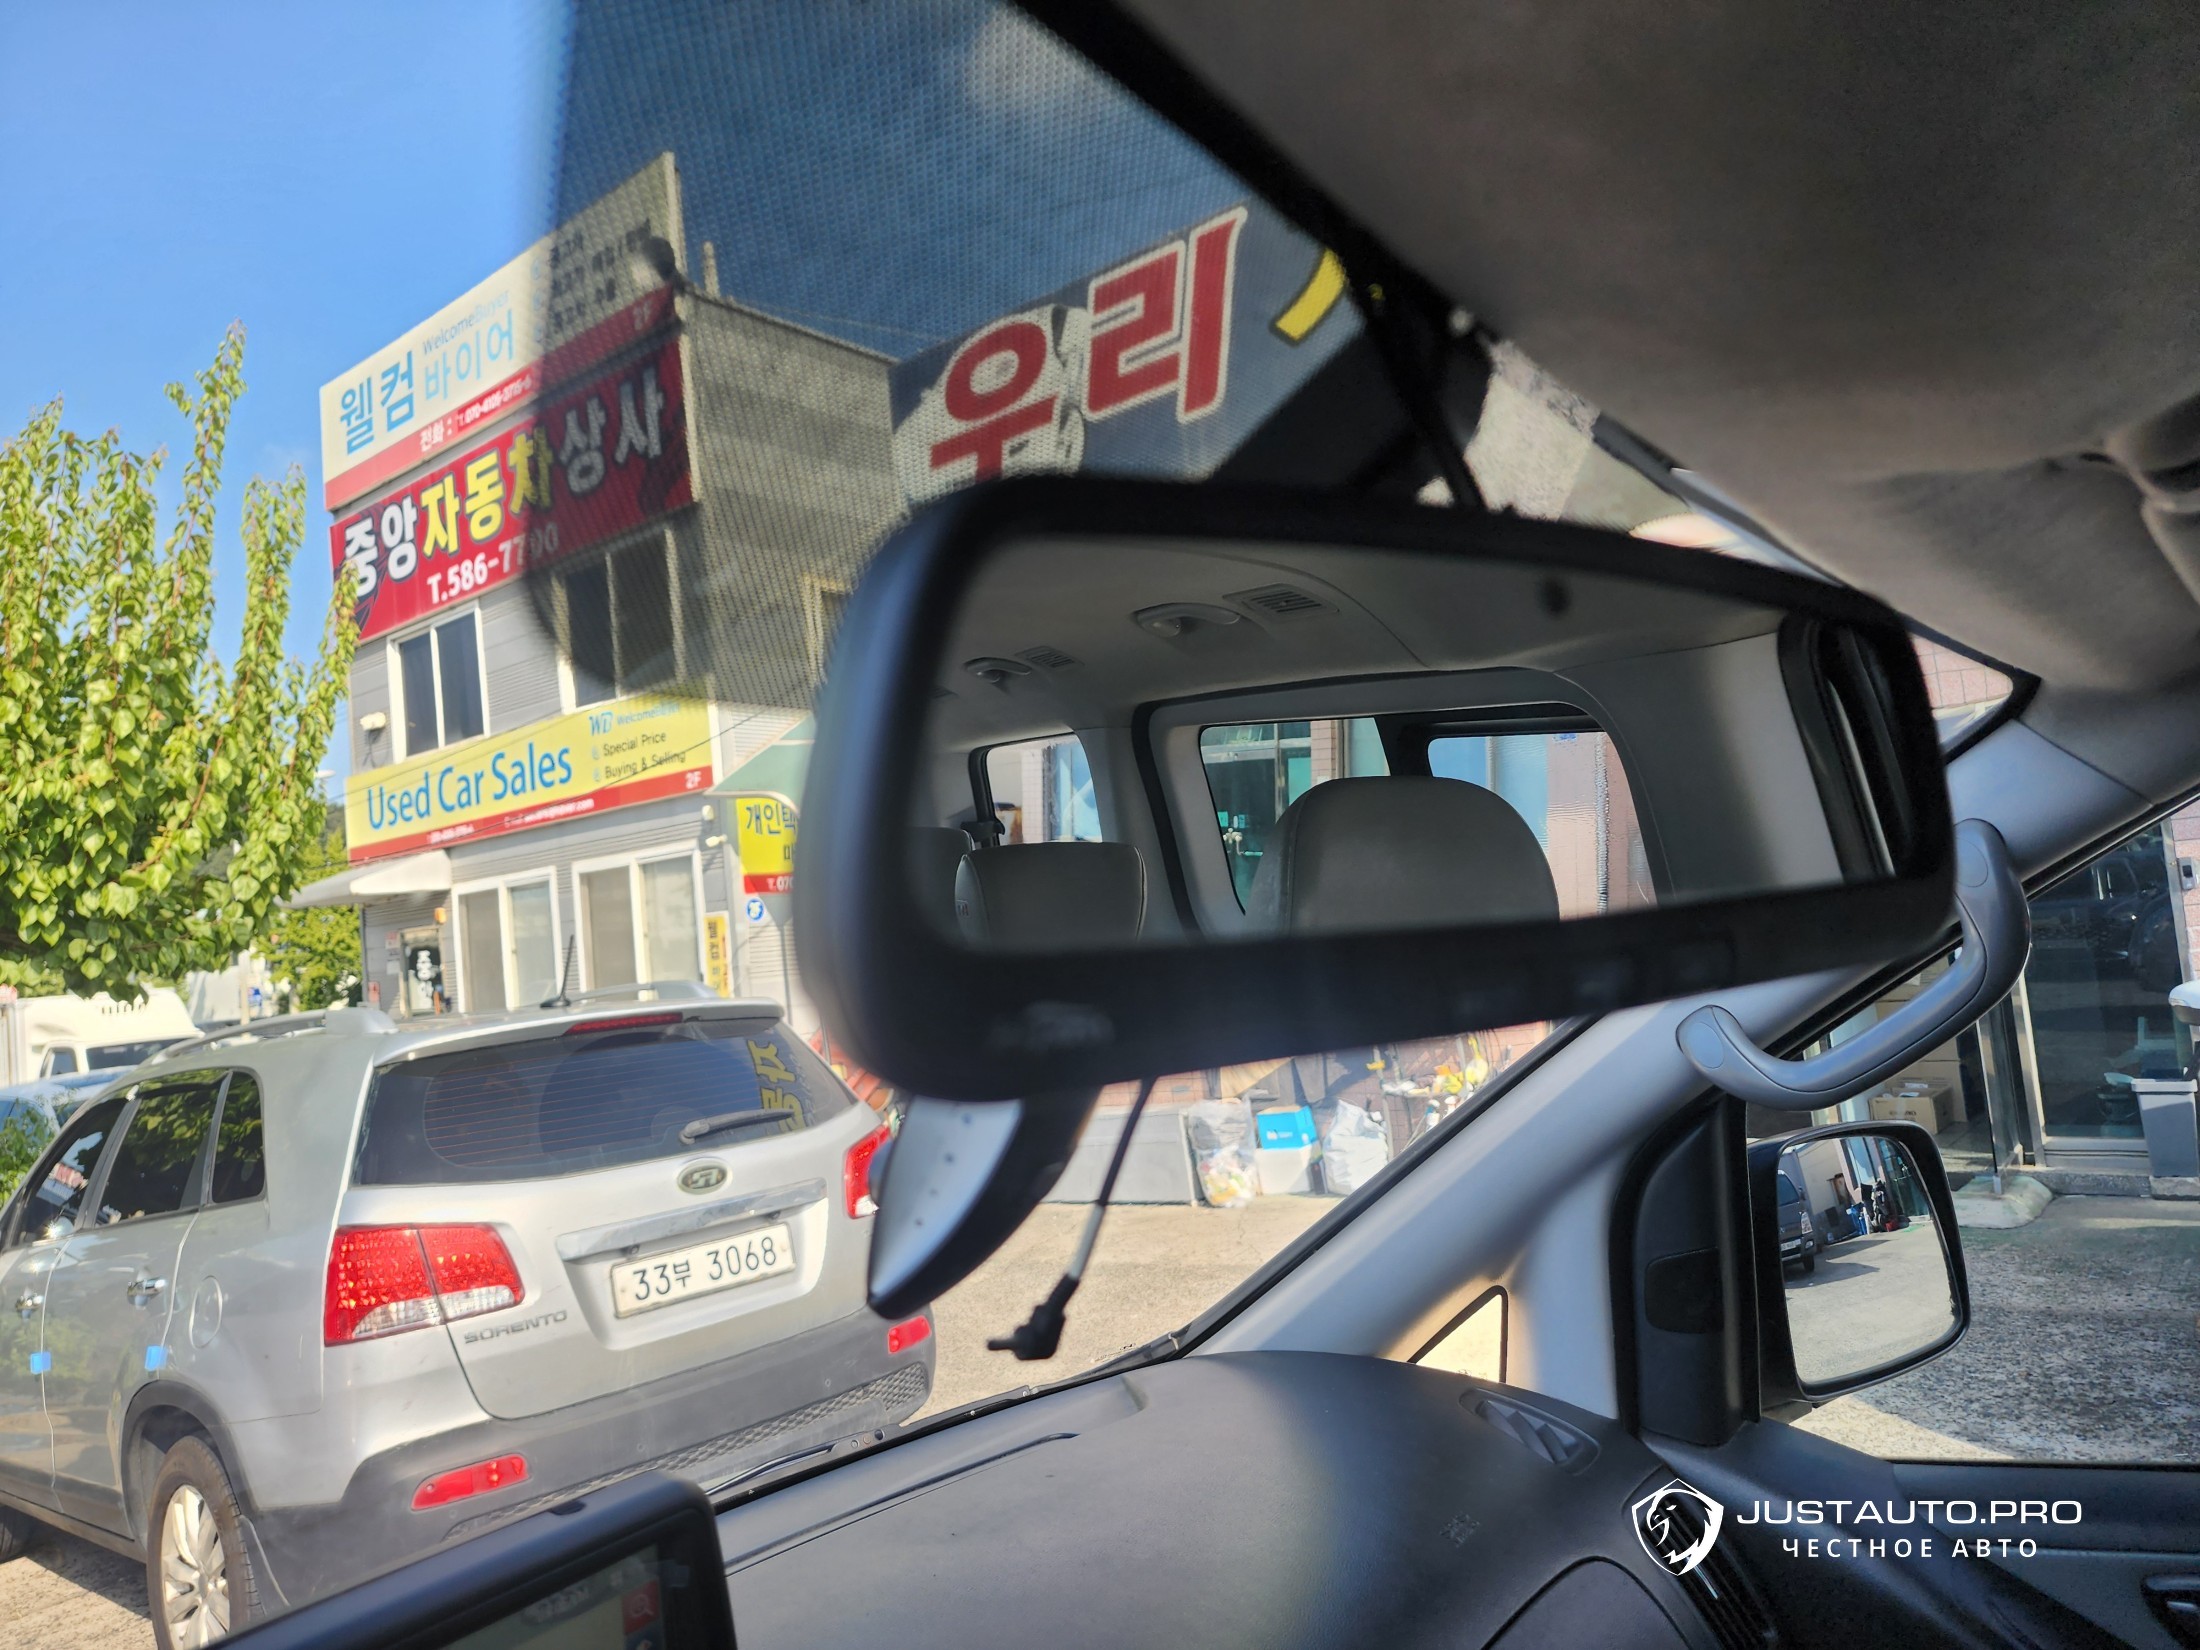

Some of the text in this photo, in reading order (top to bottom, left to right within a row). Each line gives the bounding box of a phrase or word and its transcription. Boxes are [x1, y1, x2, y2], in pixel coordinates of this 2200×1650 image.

[340, 308, 513, 455] 웰컴 바이어
[603, 732, 667, 757] Special Price
[604, 761, 638, 780] Buying
[651, 750, 687, 766] Selling
[367, 771, 431, 830] Used
[438, 765, 485, 813] Car
[491, 742, 573, 801] Sales
[633, 1237, 777, 1301] 33부 3068
[464, 1310, 568, 1344] SORENTO
